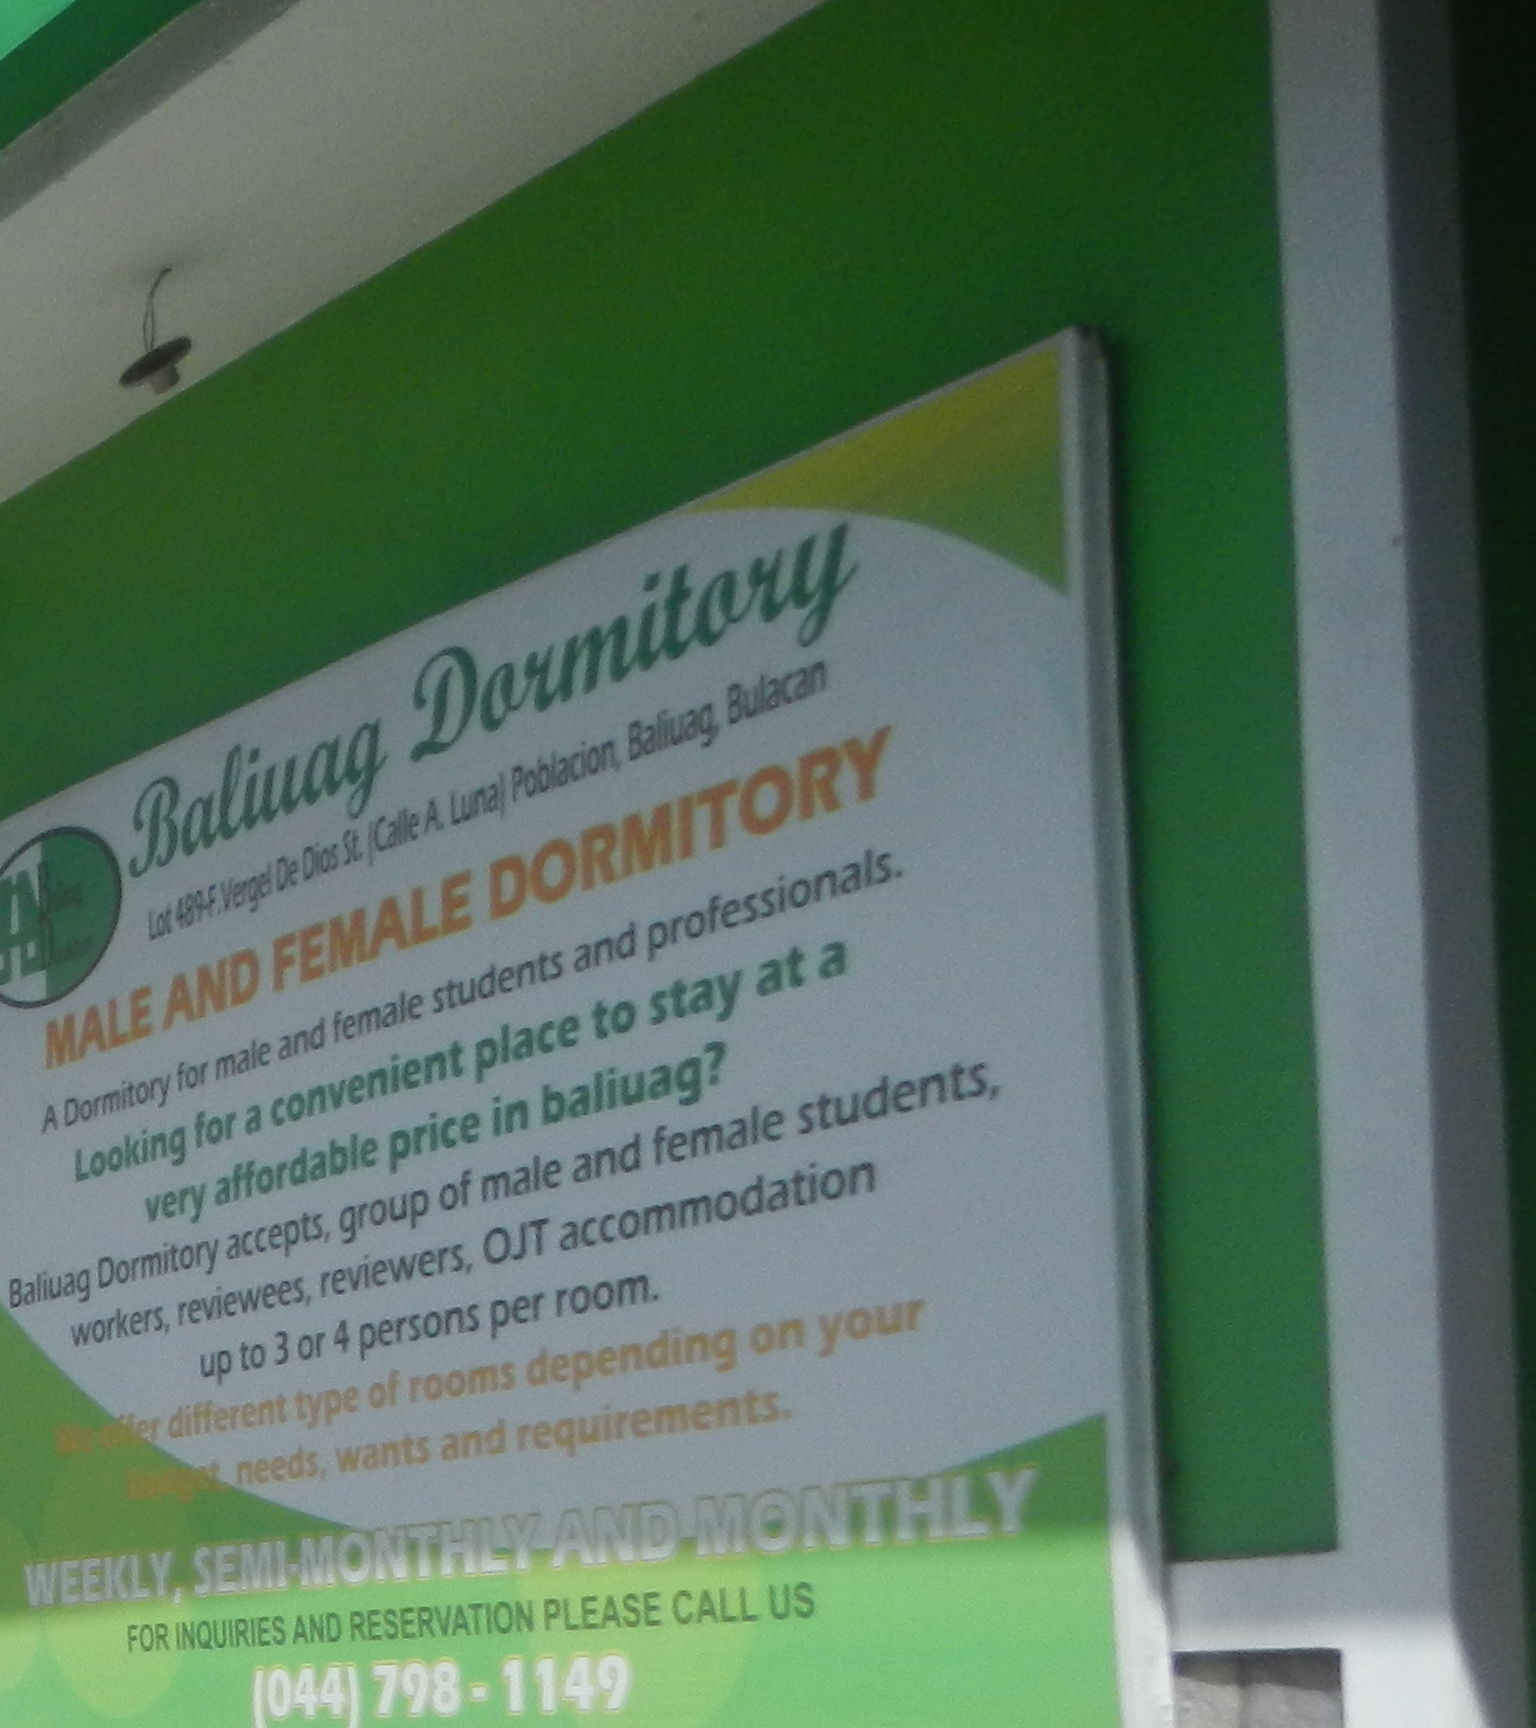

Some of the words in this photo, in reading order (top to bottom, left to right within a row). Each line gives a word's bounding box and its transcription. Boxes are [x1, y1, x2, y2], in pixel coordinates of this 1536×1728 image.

[129, 717, 387, 878] Baliuag
[411, 520, 857, 762] Dormitory
[147, 904, 172, 941] Lot
[275, 855, 299, 892] De
[302, 842, 339, 881] Dios
[511, 736, 623, 804] Poblacion,
[628, 702, 721, 762] Baliuag,
[727, 659, 827, 726] Bulacan
[45, 985, 153, 1070] MALE
[161, 947, 260, 1031] AND
[272, 870, 473, 992] FEMALE
[489, 724, 893, 921] DORMITORY
[41, 1105, 60, 1133] A
[64, 1073, 171, 1128] Dormitory
[176, 1060, 209, 1092] for
[214, 1040, 271, 1080] male
[277, 1018, 326, 1059] and
[332, 991, 425, 1044] female
[432, 949, 564, 1013] students
[574, 922, 638, 974] and
[647, 847, 904, 962] professionals.
[74, 1126, 187, 1183] Looking
[195, 1110, 237, 1149] for
[243, 1103, 264, 1134] a
[270, 1039, 465, 1127] convenient
[475, 1013, 581, 1084] place
[590, 998, 637, 1040] to
[648, 968, 743, 1028] stay
[755, 946, 807, 998] at
[818, 940, 849, 980] a
[7, 1268, 92, 1309] Baliuag
[96, 1238, 219, 1290] Dormitory
[225, 1210, 332, 1260] accepts,
[339, 1187, 429, 1245] group
[438, 1169, 473, 1211] of
[480, 1155, 563, 1203] male
[572, 1134, 644, 1184] and
[652, 1105, 786, 1167] female
[797, 1060, 1004, 1135] students,
[144, 1184, 207, 1224] very
[214, 1133, 378, 1208] affordable
[388, 1108, 481, 1174] price
[491, 1096, 530, 1138] in
[541, 1040, 728, 1127] baliuag?
[71, 1305, 171, 1347] workers,
[176, 1276, 312, 1327] reviewees,
[319, 1242, 473, 1299] reviewers,
[482, 1217, 550, 1265] OJT
[558, 1160, 878, 1252] accommodation
[199, 1349, 233, 1385] up
[239, 1341, 267, 1372] to
[274, 1331, 290, 1366] 3
[296, 1331, 326, 1360] or
[333, 1318, 351, 1354] 4
[358, 1301, 481, 1361] persons
[489, 1289, 547, 1339] per
[554, 1273, 661, 1315] room.
[167, 1395, 289, 1439] different
[294, 1387, 359, 1430] type
[367, 1369, 401, 1409] of
[409, 1361, 516, 1401] rooms
[526, 1326, 737, 1391] depending
[749, 1315, 805, 1354] on
[817, 1298, 926, 1358] your
[237, 1446, 325, 1486] needs,
[335, 1430, 431, 1474] wants
[440, 1420, 507, 1461] and
[517, 1390, 793, 1457] requirements.
[24, 1549, 183, 1608] WEEKLY,
[191, 1512, 540, 1597] SEMI-MONTHLY
[550, 1501, 678, 1569] AND
[694, 1464, 1038, 1559] MONTHLY
[127, 1622, 171, 1653] FOR
[175, 1614, 287, 1650] INQUIRIES
[292, 1612, 342, 1645] AND
[349, 1598, 534, 1642] RESERVATION
[542, 1589, 662, 1632] PLEASE
[671, 1585, 759, 1625] CALL
[767, 1581, 816, 1620] US
[370, 1657, 462, 1717] 798
[501, 1652, 632, 1715] 1149
